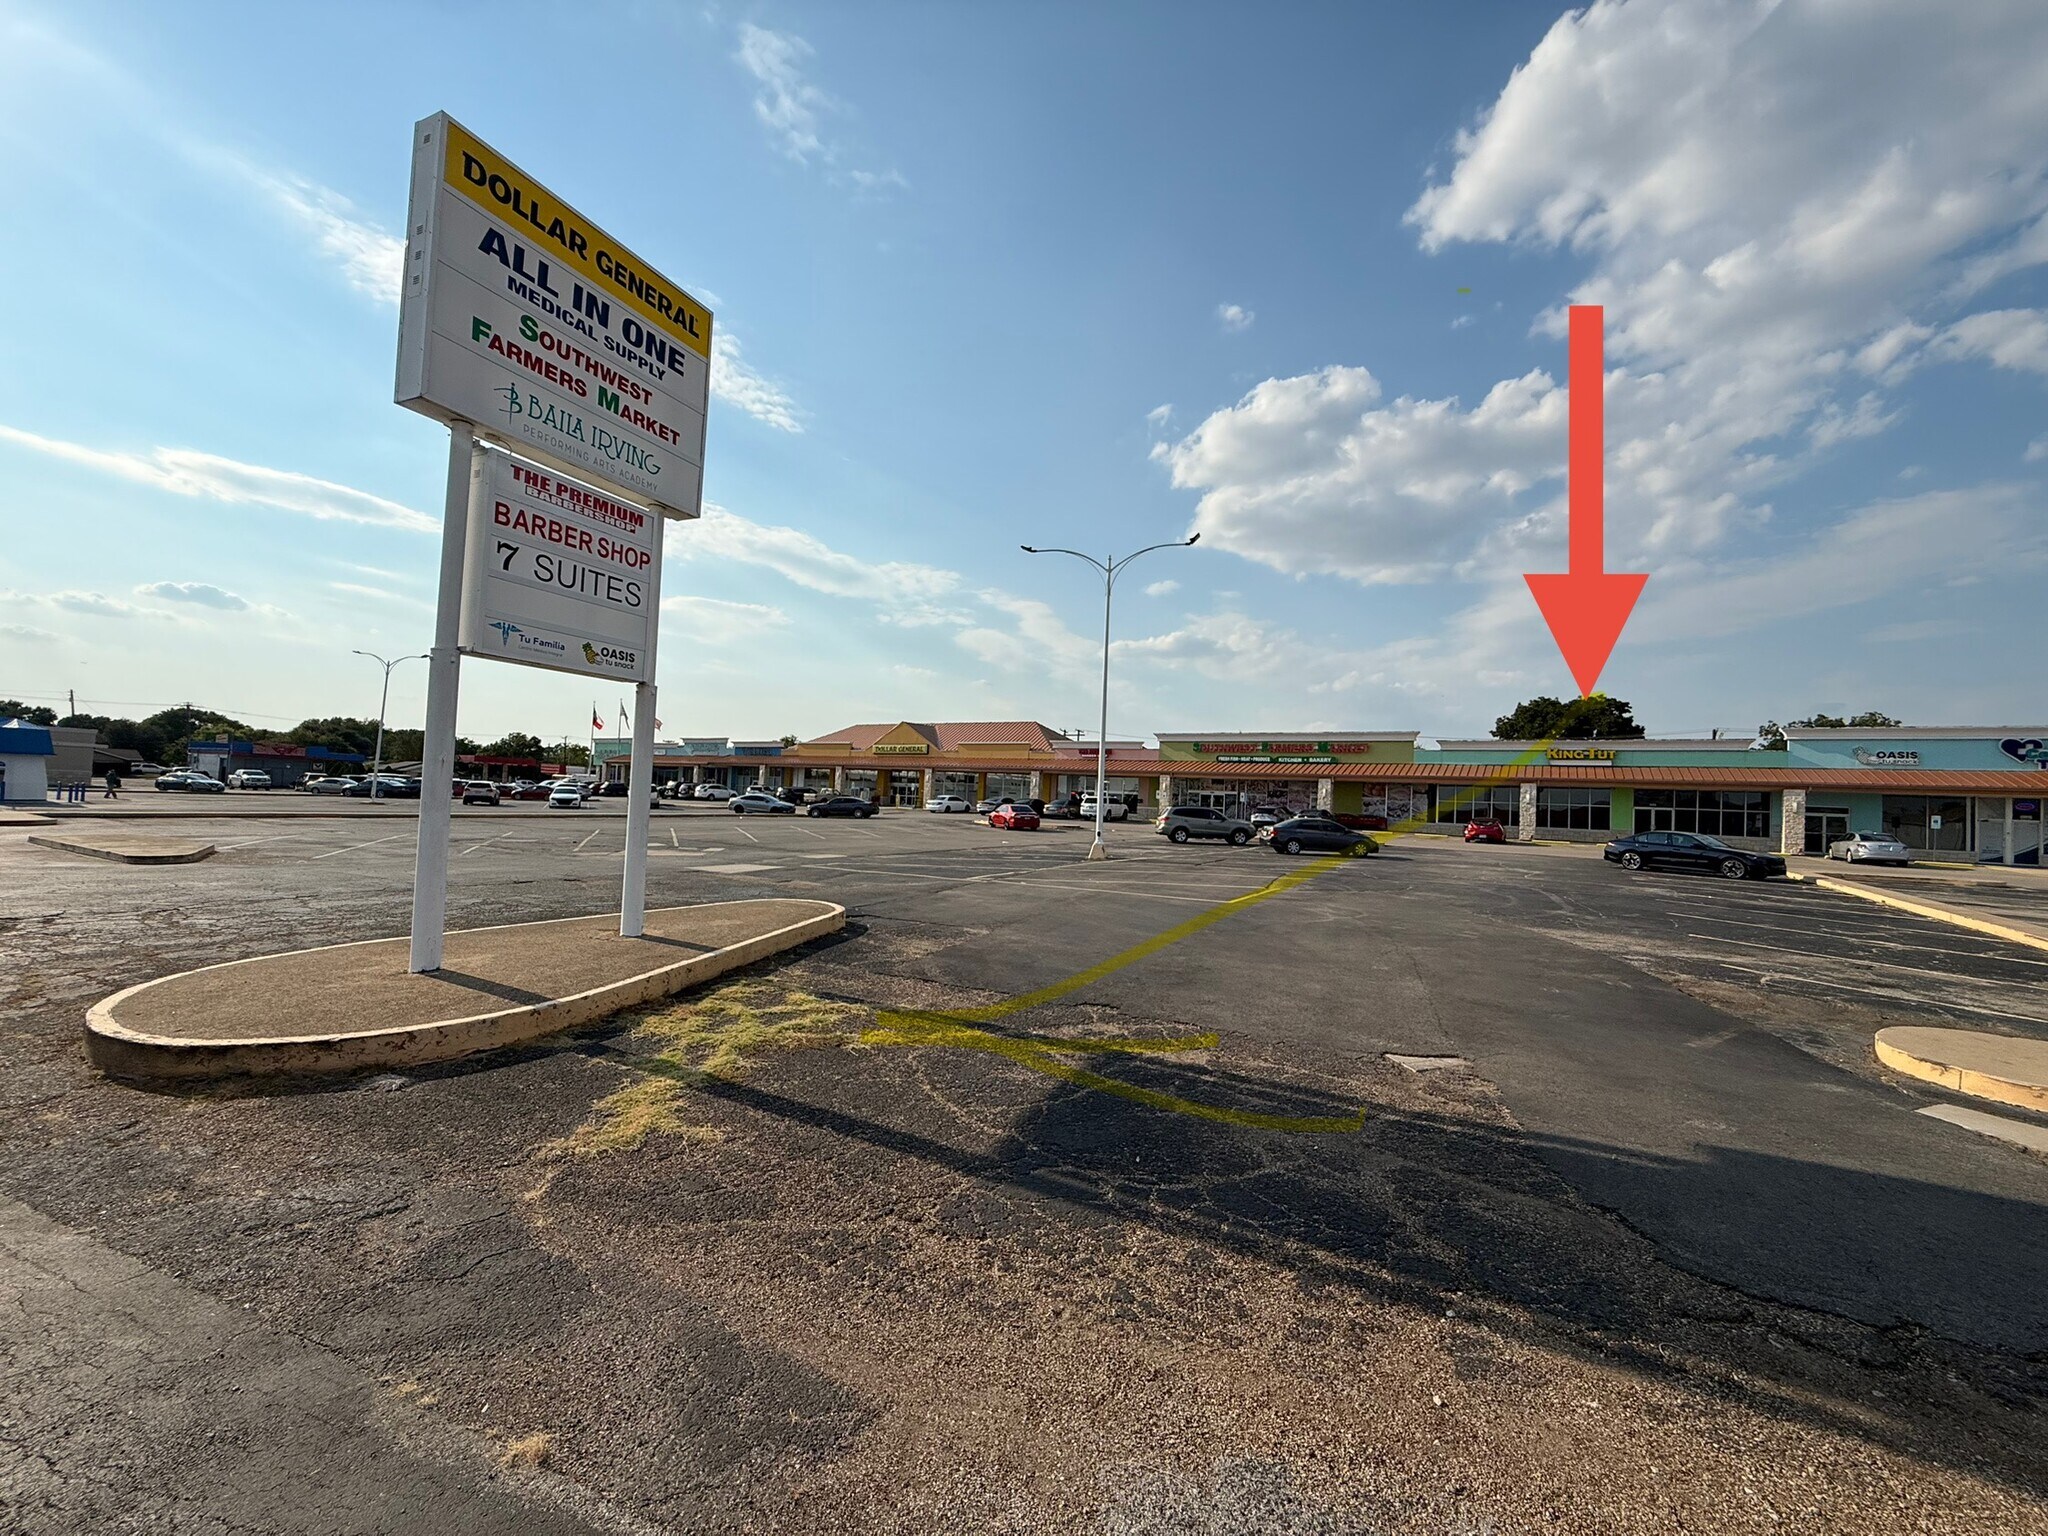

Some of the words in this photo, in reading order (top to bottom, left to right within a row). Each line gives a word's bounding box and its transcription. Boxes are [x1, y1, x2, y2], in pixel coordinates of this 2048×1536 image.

[462, 150, 589, 262] DOLLAR
[595, 249, 700, 340] GENERAL
[477, 226, 560, 298] ALL
[572, 282, 611, 330] IN
[621, 317, 686, 377] ONE
[506, 275, 598, 342] MEDICAL
[603, 335, 667, 381] SUPPLY
[471, 315, 588, 398] FARMERS
[597, 385, 681, 446] MARKET
[518, 314, 653, 406] SOUTHWEST
[523, 423, 590, 462] PERFORMING
[592, 456, 616, 474] ARTS
[618, 469, 659, 493] ACADEMY
[527, 394, 586, 443] BAILA
[590, 425, 662, 475] IRVING
[510, 463, 551, 493] THE
[556, 481, 644, 528] PREMIUM
[526, 485, 636, 534] BARBERSHOP
[494, 500, 593, 555] BARBER
[596, 537, 651, 571] SHOP
[496, 540, 520, 571] 7
[533, 553, 642, 608] SUITES
[518, 633, 531, 645] Tu
[533, 637, 566, 652] Familia
[600, 647, 636, 664] OASIS
[614, 661, 635, 671] snack
[875, 745, 898, 753] DOLLAR
[898, 745, 924, 753] GENERAL
[1876, 751, 1919, 759] OASIS
